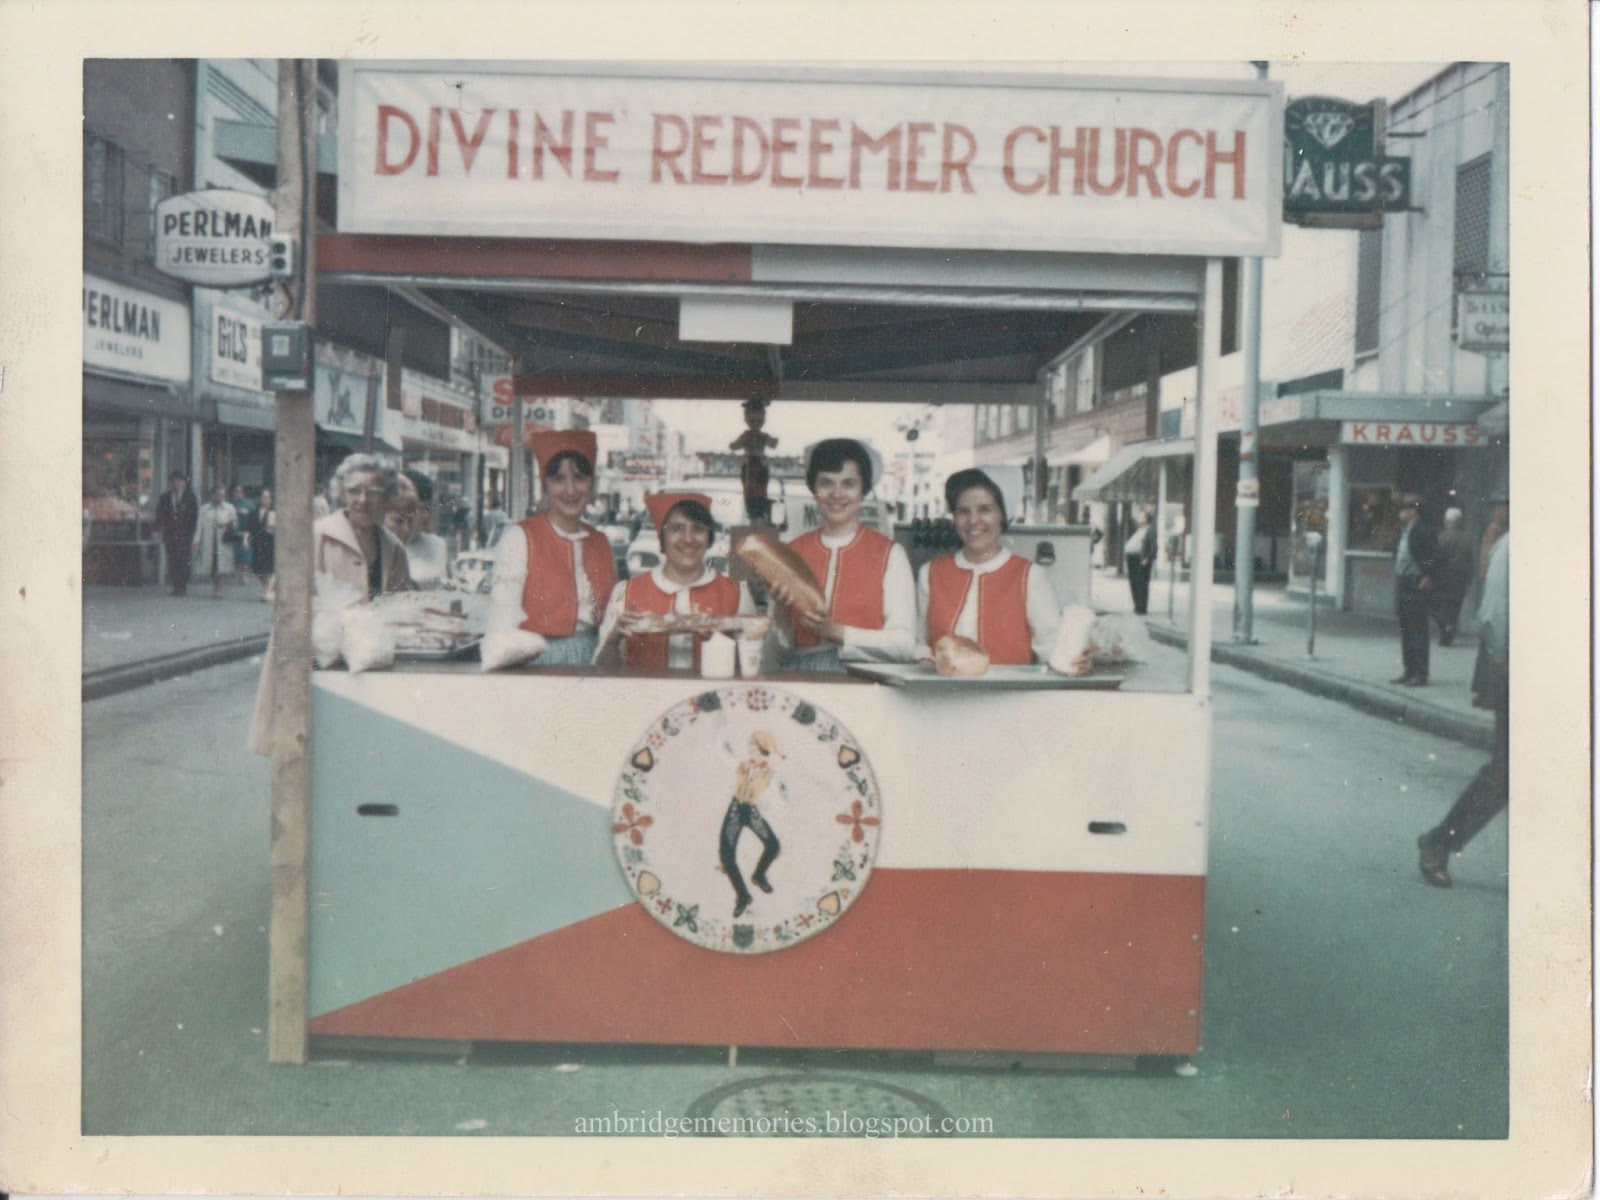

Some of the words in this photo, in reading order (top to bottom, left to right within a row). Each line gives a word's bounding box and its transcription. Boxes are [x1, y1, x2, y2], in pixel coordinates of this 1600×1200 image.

[375, 104, 620, 183] DIVINE
[650, 112, 978, 194] REDEEMER
[1002, 124, 1246, 200] CHURCH
[1289, 156, 1402, 202] AUSS
[163, 209, 272, 240] PERLMAN
[171, 246, 265, 265] JEWELERS
[1352, 422, 1481, 445] KRAUSS
